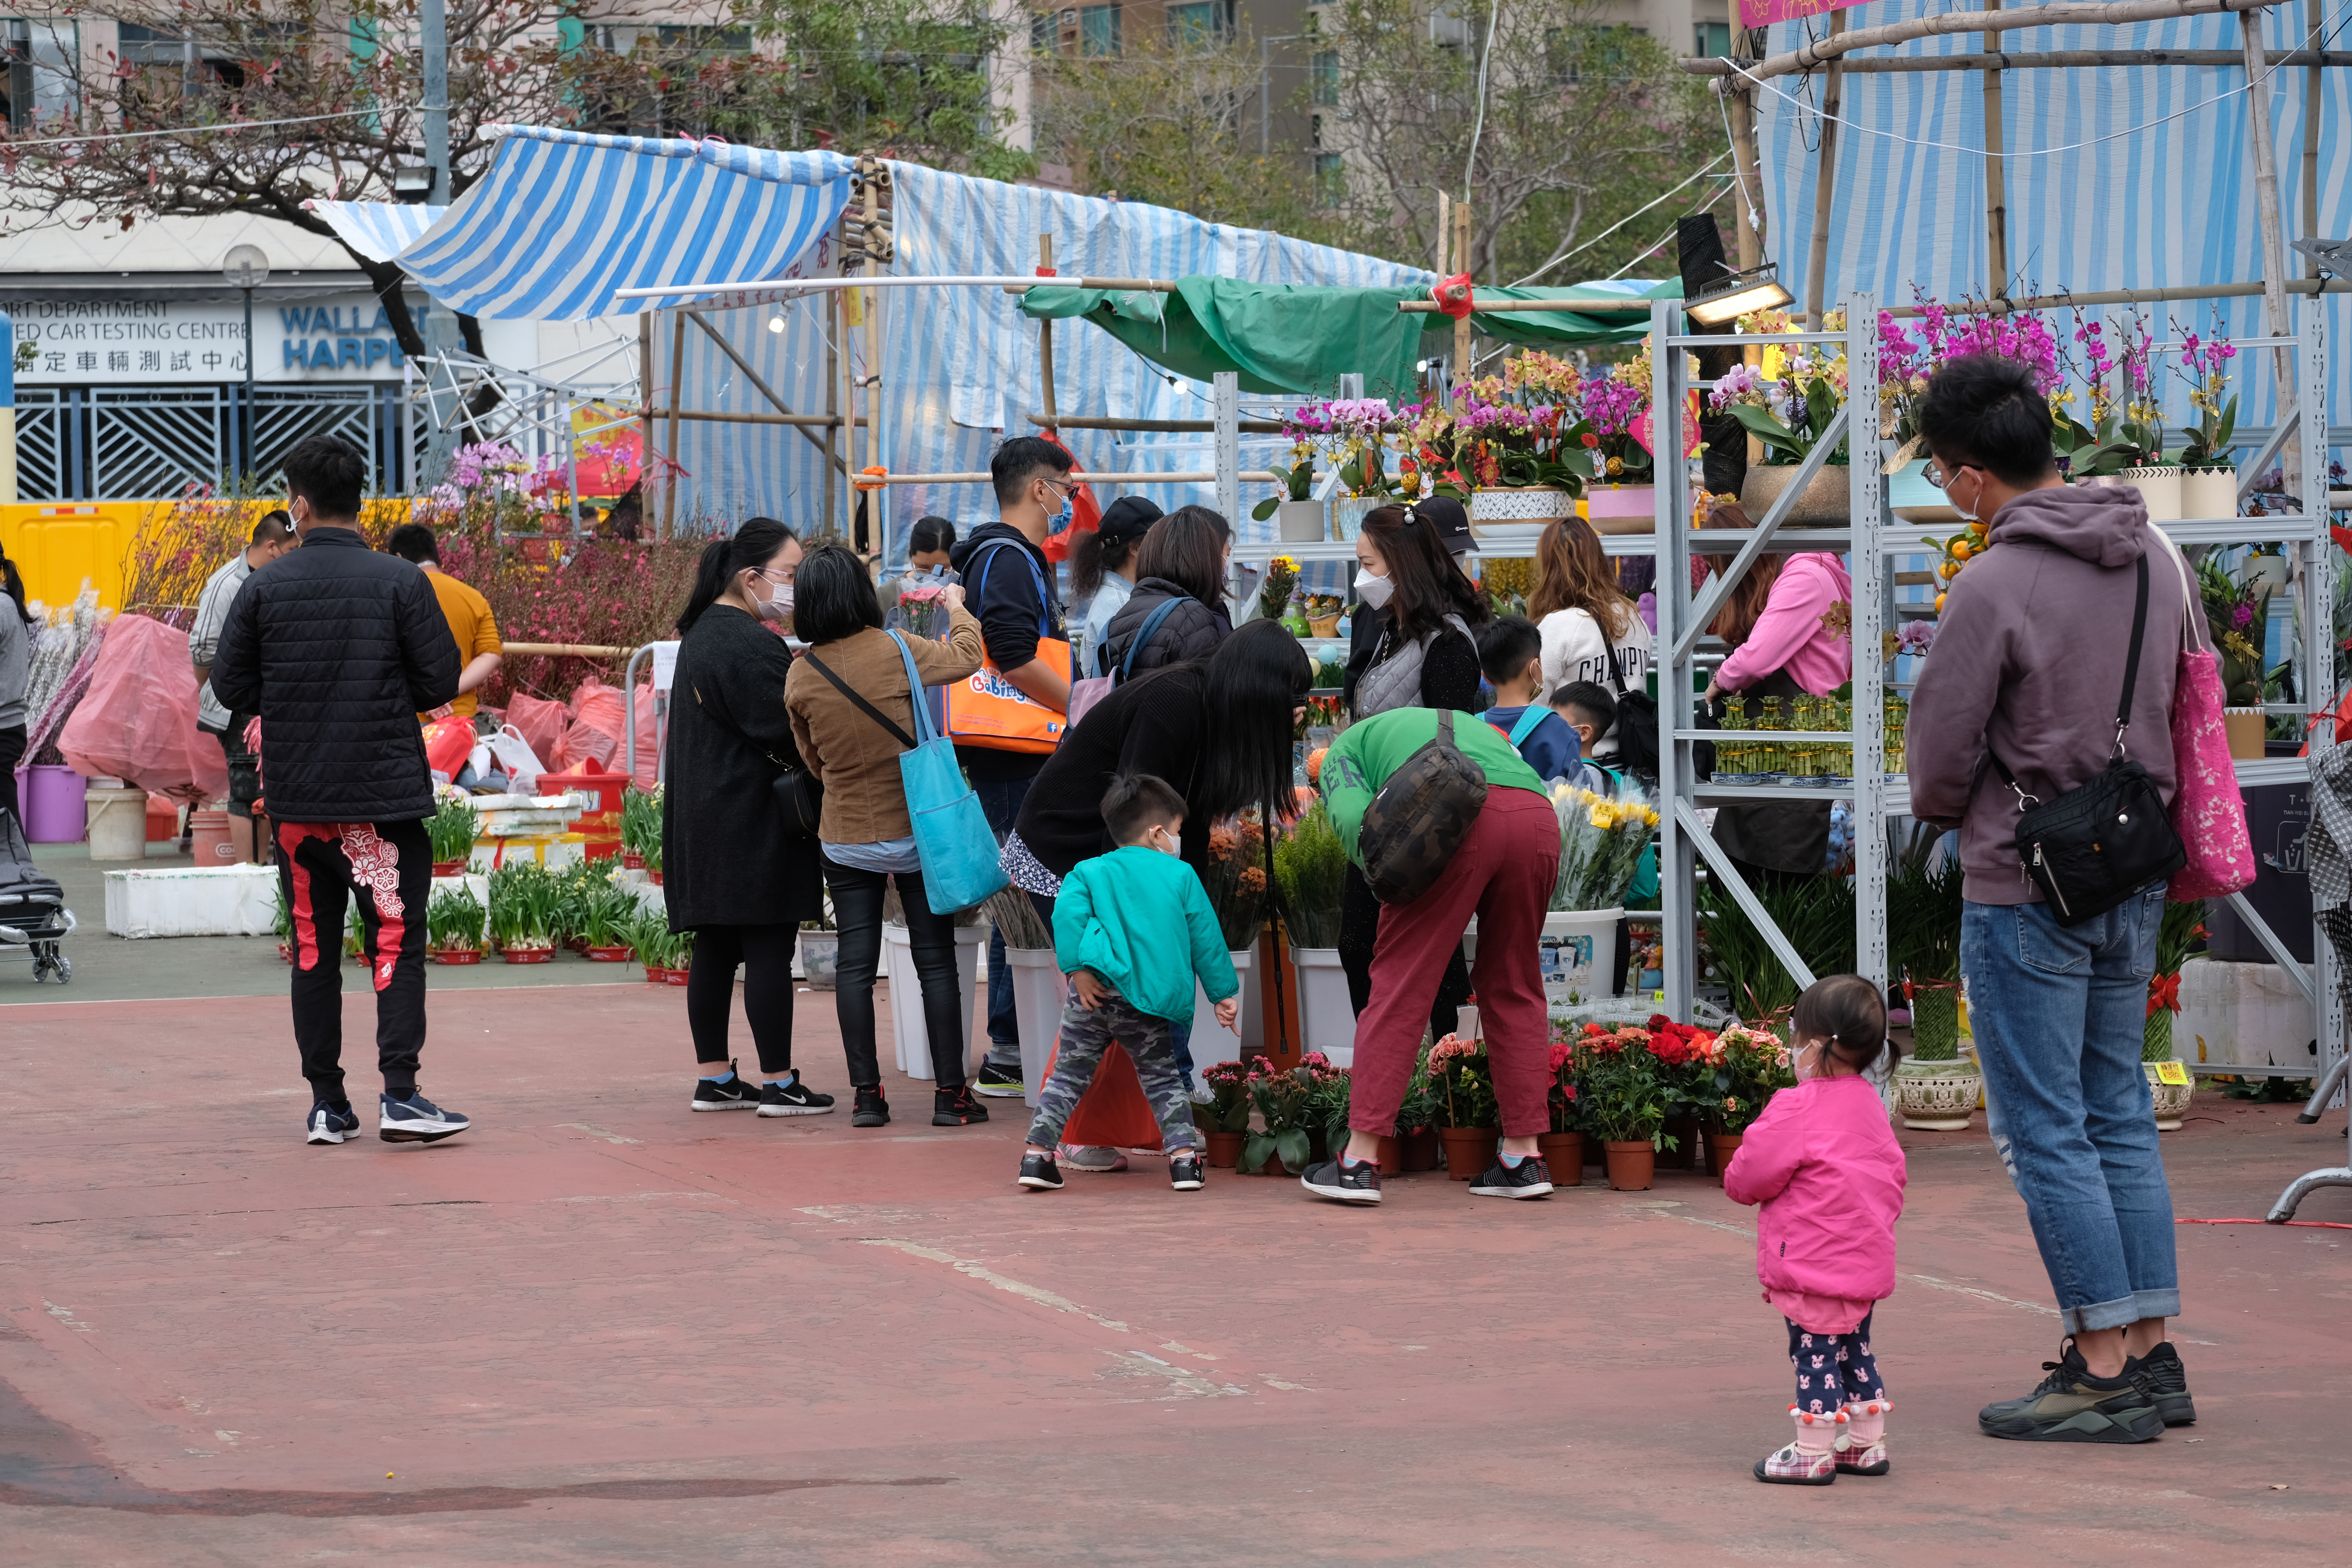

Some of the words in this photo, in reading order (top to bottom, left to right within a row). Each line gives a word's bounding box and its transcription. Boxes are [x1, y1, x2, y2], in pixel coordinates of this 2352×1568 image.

[39, 301, 167, 318] DEPARTMENT
[12, 323, 41, 341] ED
[47, 323, 86, 340] CAR
[90, 323, 171, 340] TESTING
[283, 338, 407, 368] HARPE
